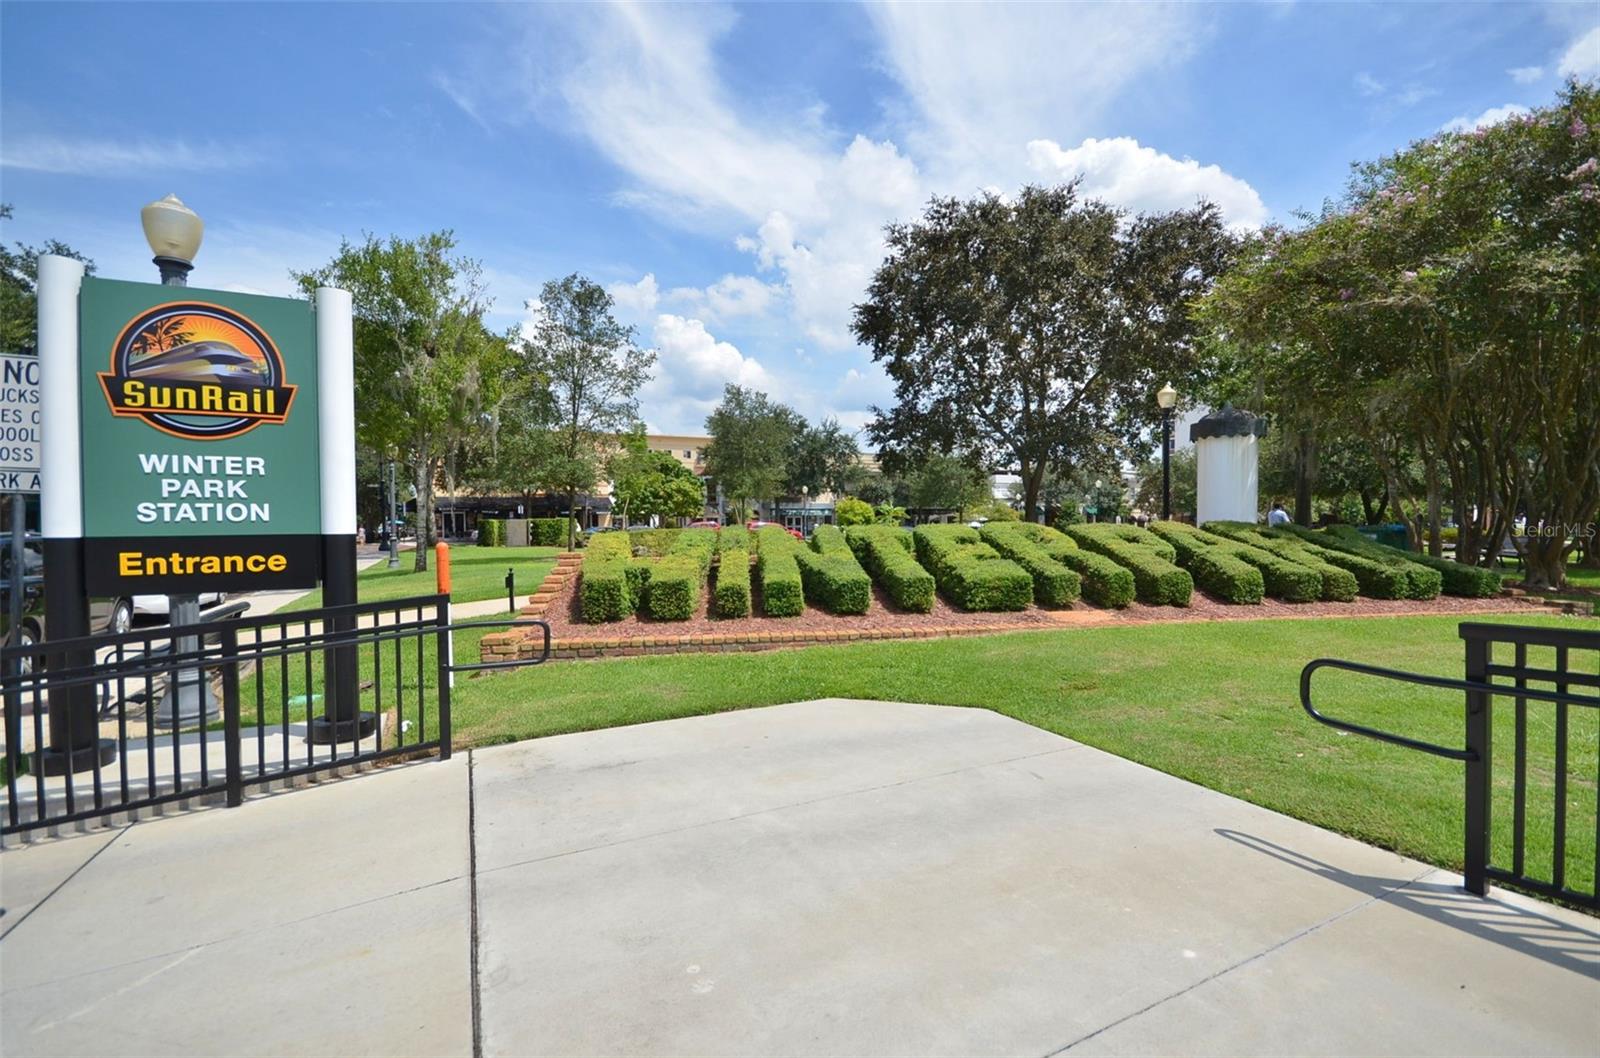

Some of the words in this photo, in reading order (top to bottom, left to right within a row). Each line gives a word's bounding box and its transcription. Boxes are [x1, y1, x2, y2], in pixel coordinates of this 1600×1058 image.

[123, 381, 275, 414] SunRail
[138, 453, 266, 475] WINTER
[161, 479, 248, 498] PARK
[136, 502, 270, 522] STATION
[118, 551, 287, 577] Entrance
